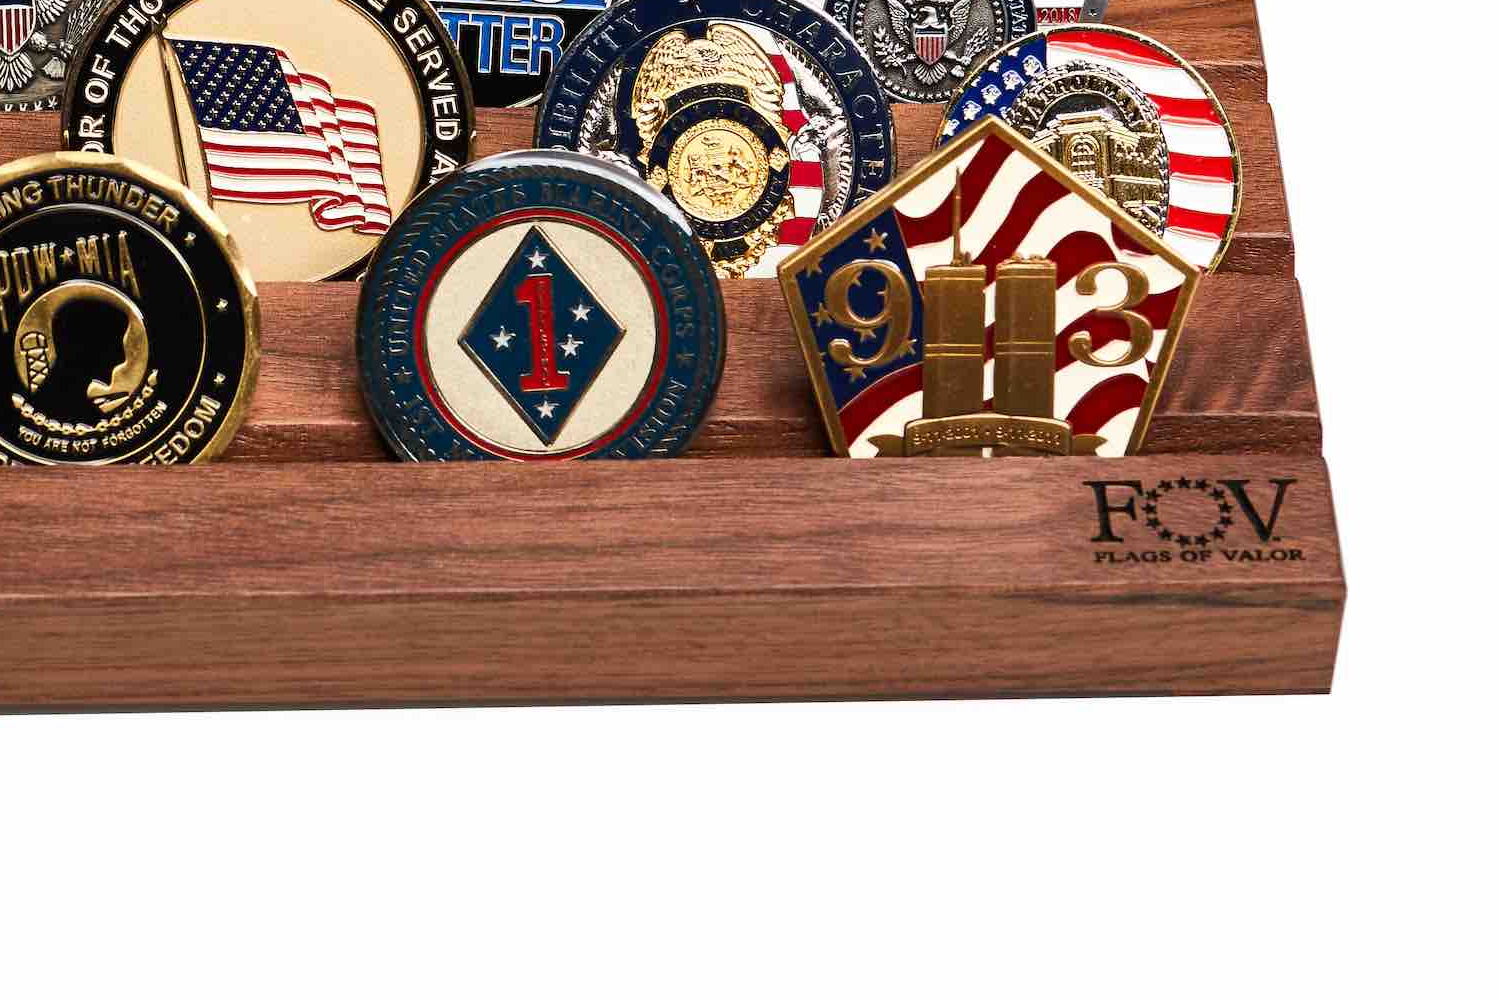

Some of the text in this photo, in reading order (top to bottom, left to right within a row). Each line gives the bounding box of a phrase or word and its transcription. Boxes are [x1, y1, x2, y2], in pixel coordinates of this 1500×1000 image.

[84, 54, 116, 106] OF
[393, 6, 463, 142] SERVED
[47, 175, 182, 232] THUNDER
[75, 230, 141, 299] MIA
[514, 272, 571, 392] 1
[18, 400, 168, 453] YOU ARE NOT FORGOTTEN
[1093, 549, 1307, 564] FLAGS OF VALOR
